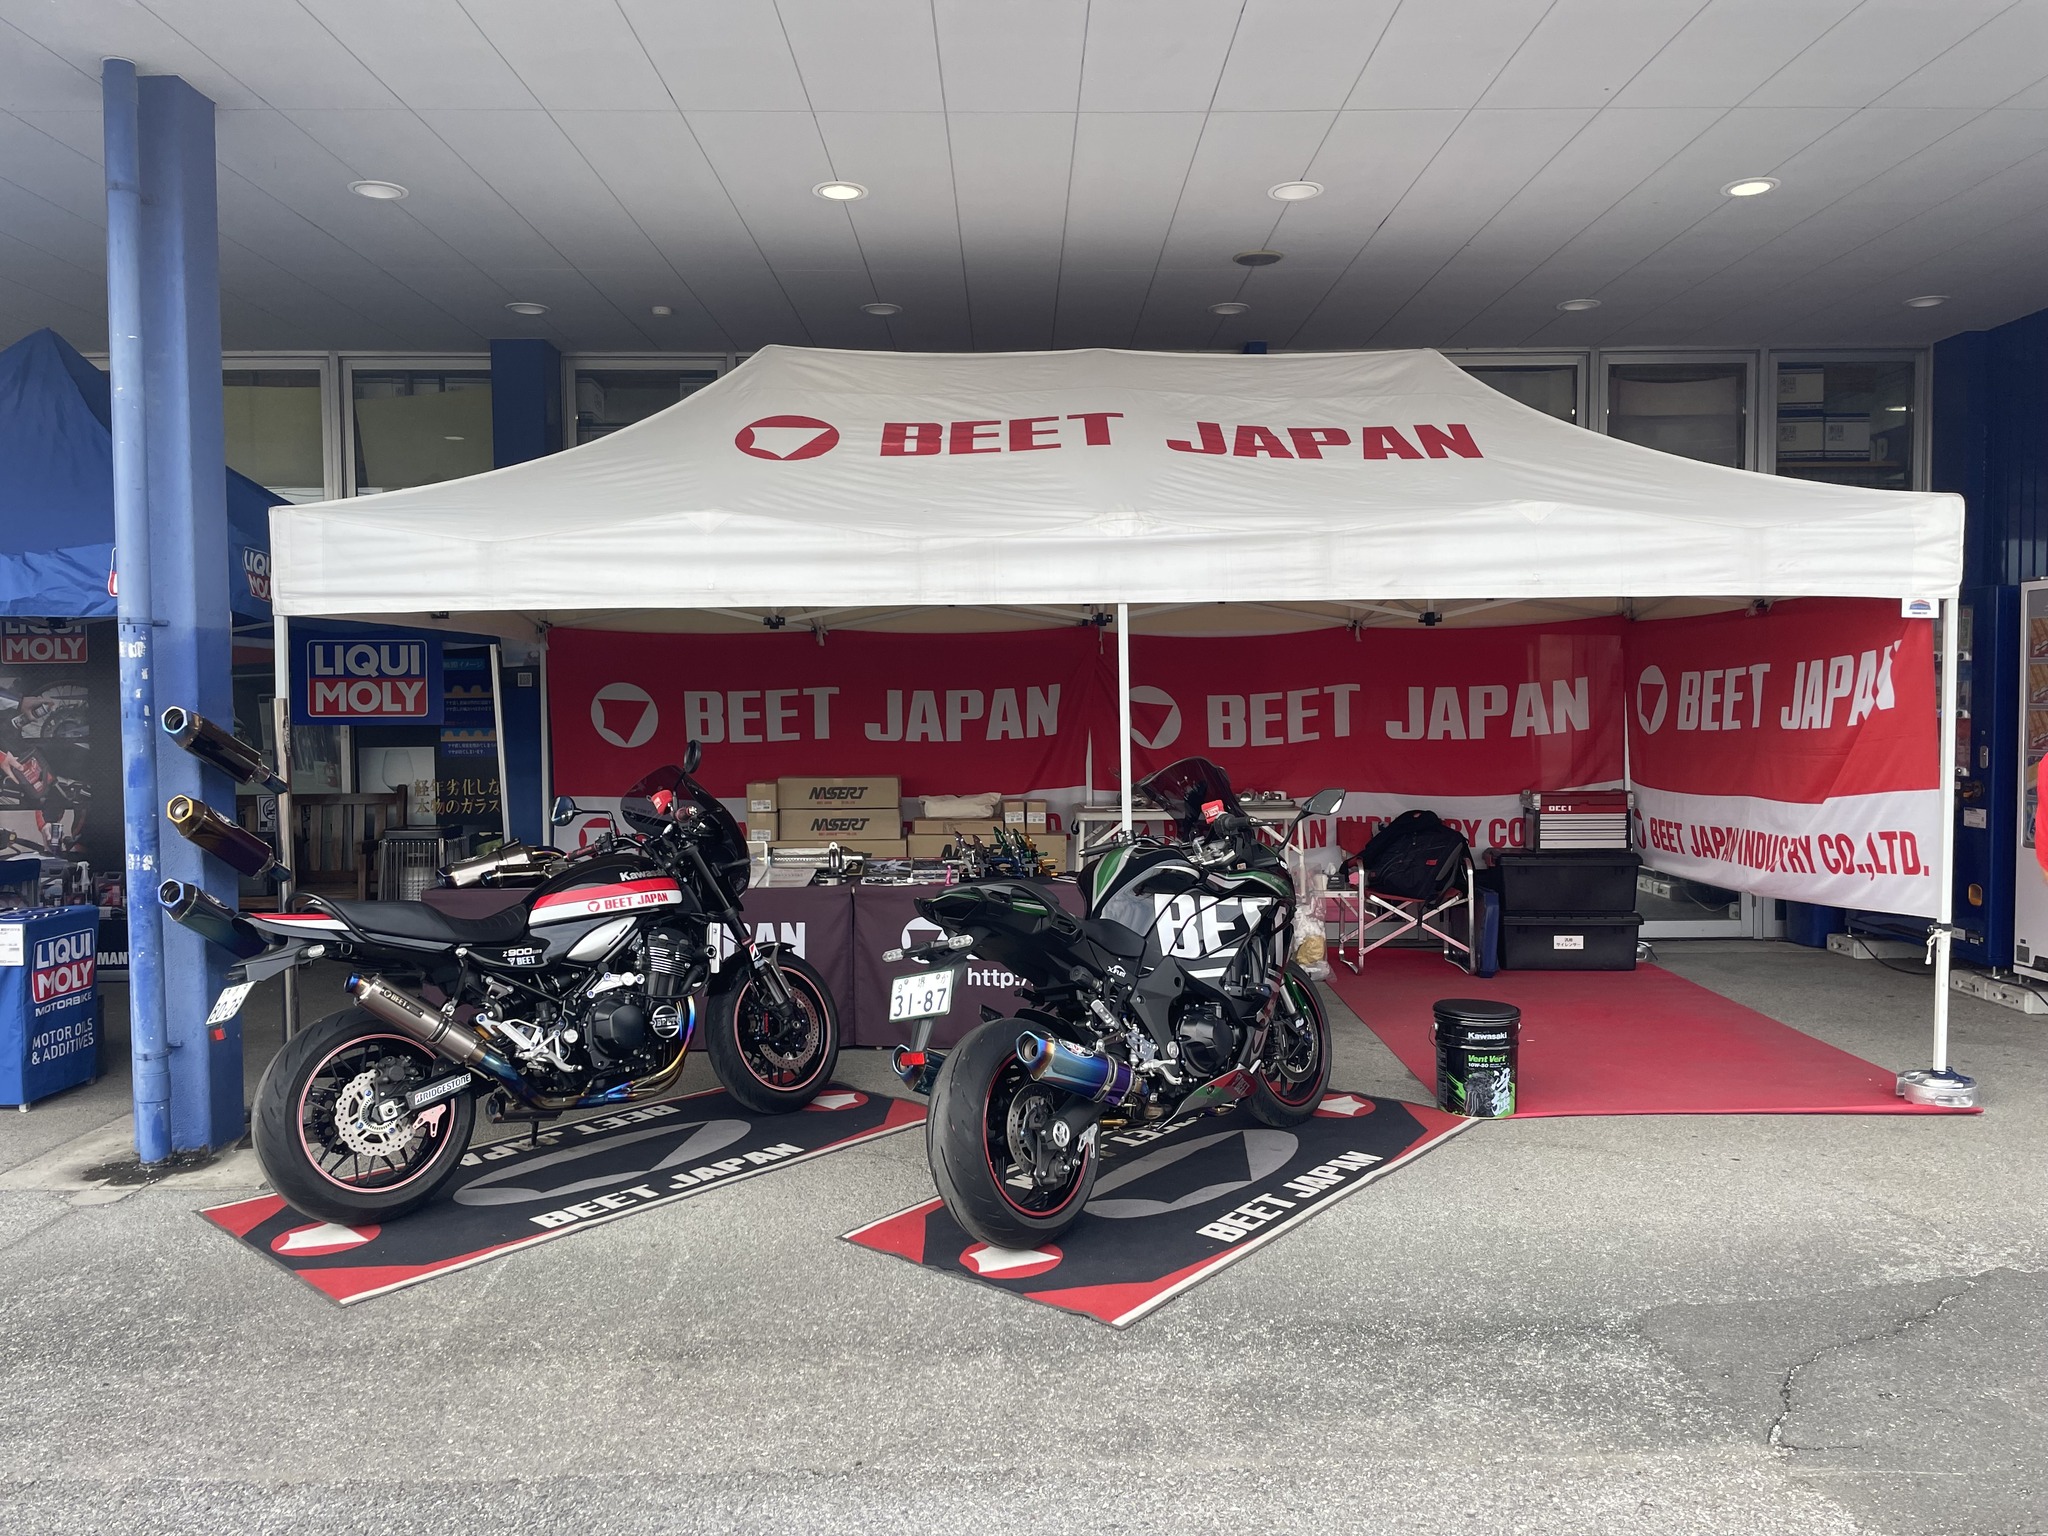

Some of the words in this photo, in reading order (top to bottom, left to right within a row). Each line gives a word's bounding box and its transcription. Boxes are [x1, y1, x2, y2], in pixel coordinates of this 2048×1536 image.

[880, 412, 1124, 457] BEET
[1166, 420, 1484, 460] JAPAN
[6, 637, 84, 661] MOLY
[314, 644, 420, 677] LIQUI
[314, 681, 424, 712] MOLY
[1207, 683, 1361, 748] BEET
[1385, 676, 1590, 741] JAPAN
[1677, 663, 1771, 731] BEET
[684, 686, 840, 744] BEET
[864, 683, 1061, 743] JAPAN
[1650, 817, 1686, 855] BEET
[604, 897, 633, 910] BEET
[637, 892, 669, 905] JAPAN
[36, 932, 92, 970] LIQUI
[37, 960, 93, 998] MOLY
[35, 991, 92, 1017] MOTORBIKE
[893, 988, 947, 1017] 31-87
[31, 1052, 41, 1065] &
[42, 1032, 94, 1062] ADDITIVES
[32, 1025, 72, 1050] MOTOR
[74, 1018, 93, 1037] OILS
[1467, 1032, 1507, 1040] Kawasaki
[416, 1073, 471, 1103] BRIDGESTONE
[573, 1104, 682, 1136] BEET
[528, 1184, 660, 1229] BEET
[668, 1143, 805, 1191] JAPAN
[1196, 1193, 1298, 1243] BEET
[1283, 1150, 1384, 1199] JAPAN
